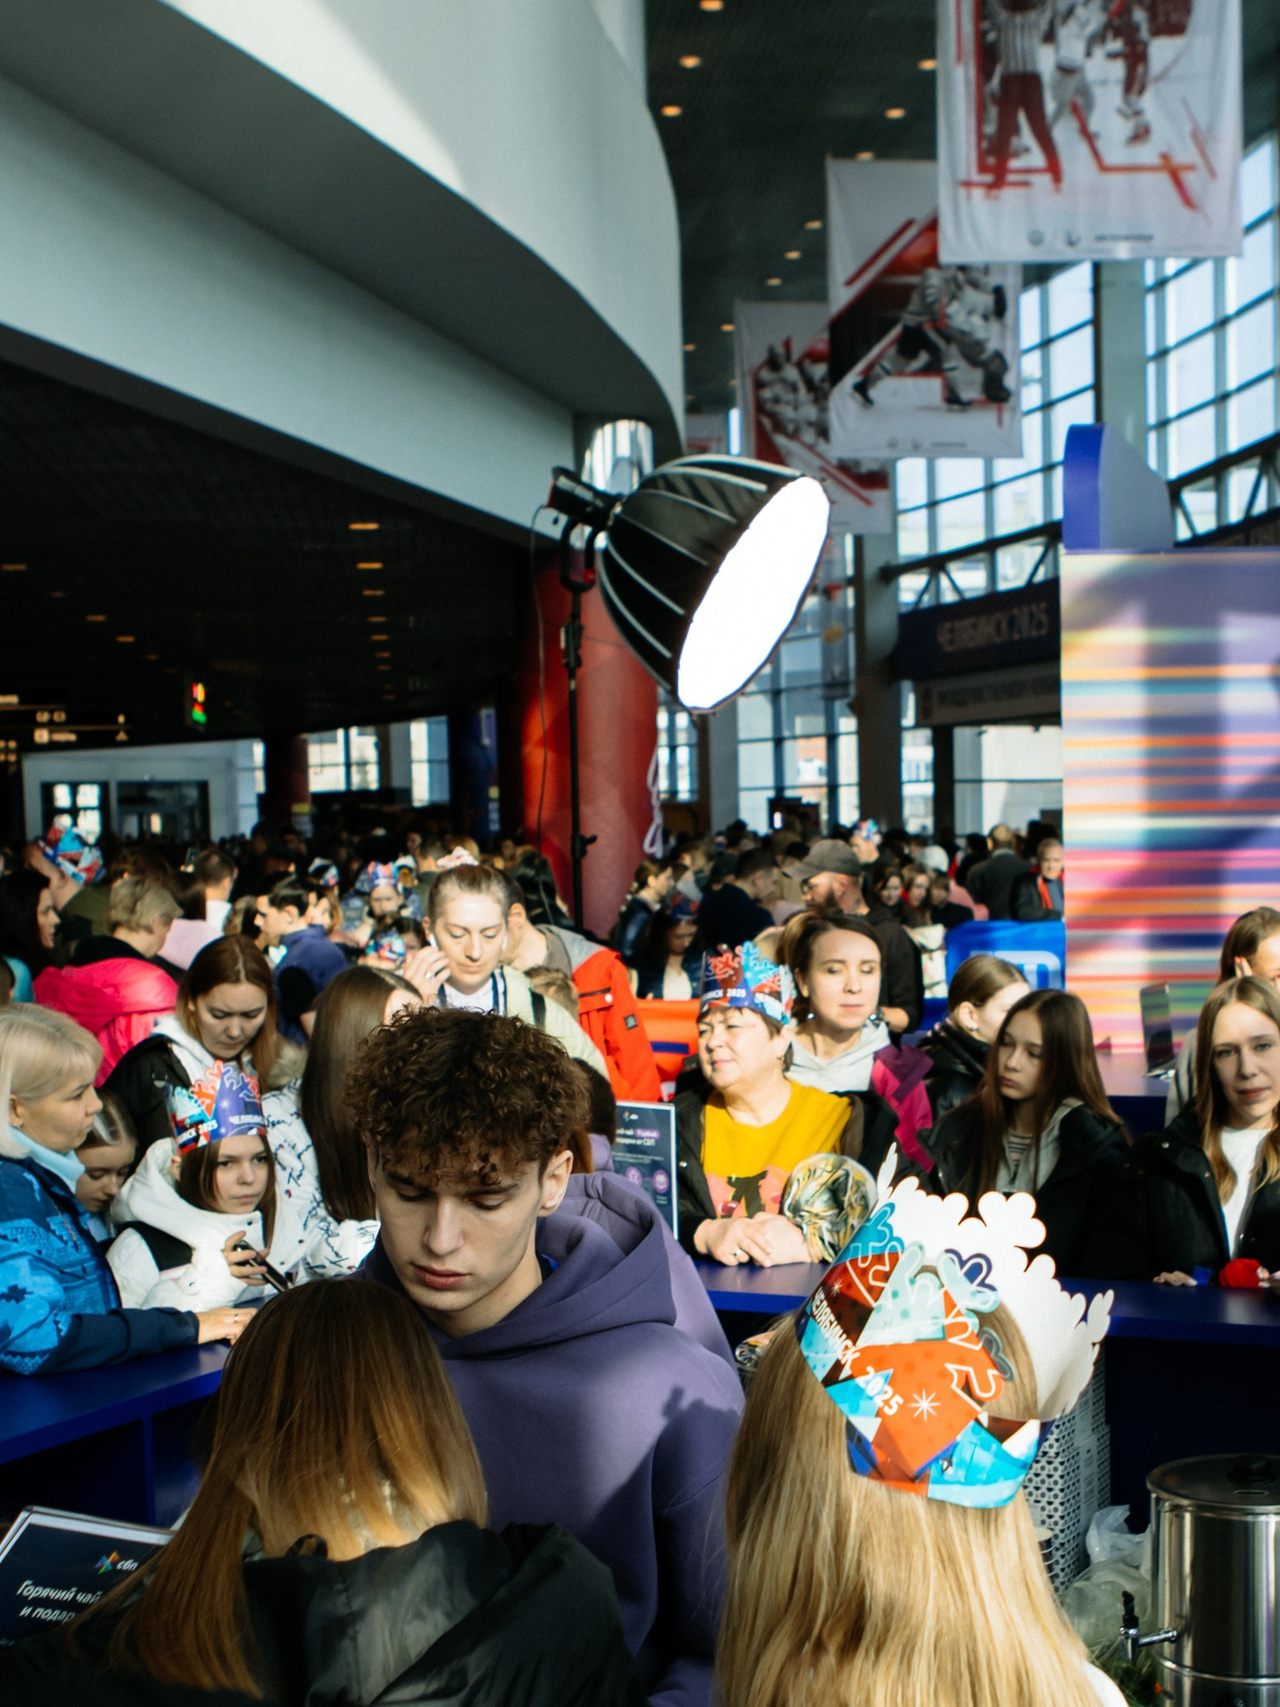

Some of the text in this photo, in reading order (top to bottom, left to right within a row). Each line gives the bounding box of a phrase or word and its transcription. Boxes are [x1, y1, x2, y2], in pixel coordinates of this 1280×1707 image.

[811, 1287, 904, 1416] ЧЕЛЯБИНСК 2025
[116, 1559, 139, 1571] сбп
[16, 1579, 104, 1605] Горячий чай
[19, 1605, 77, 1624] и подар
